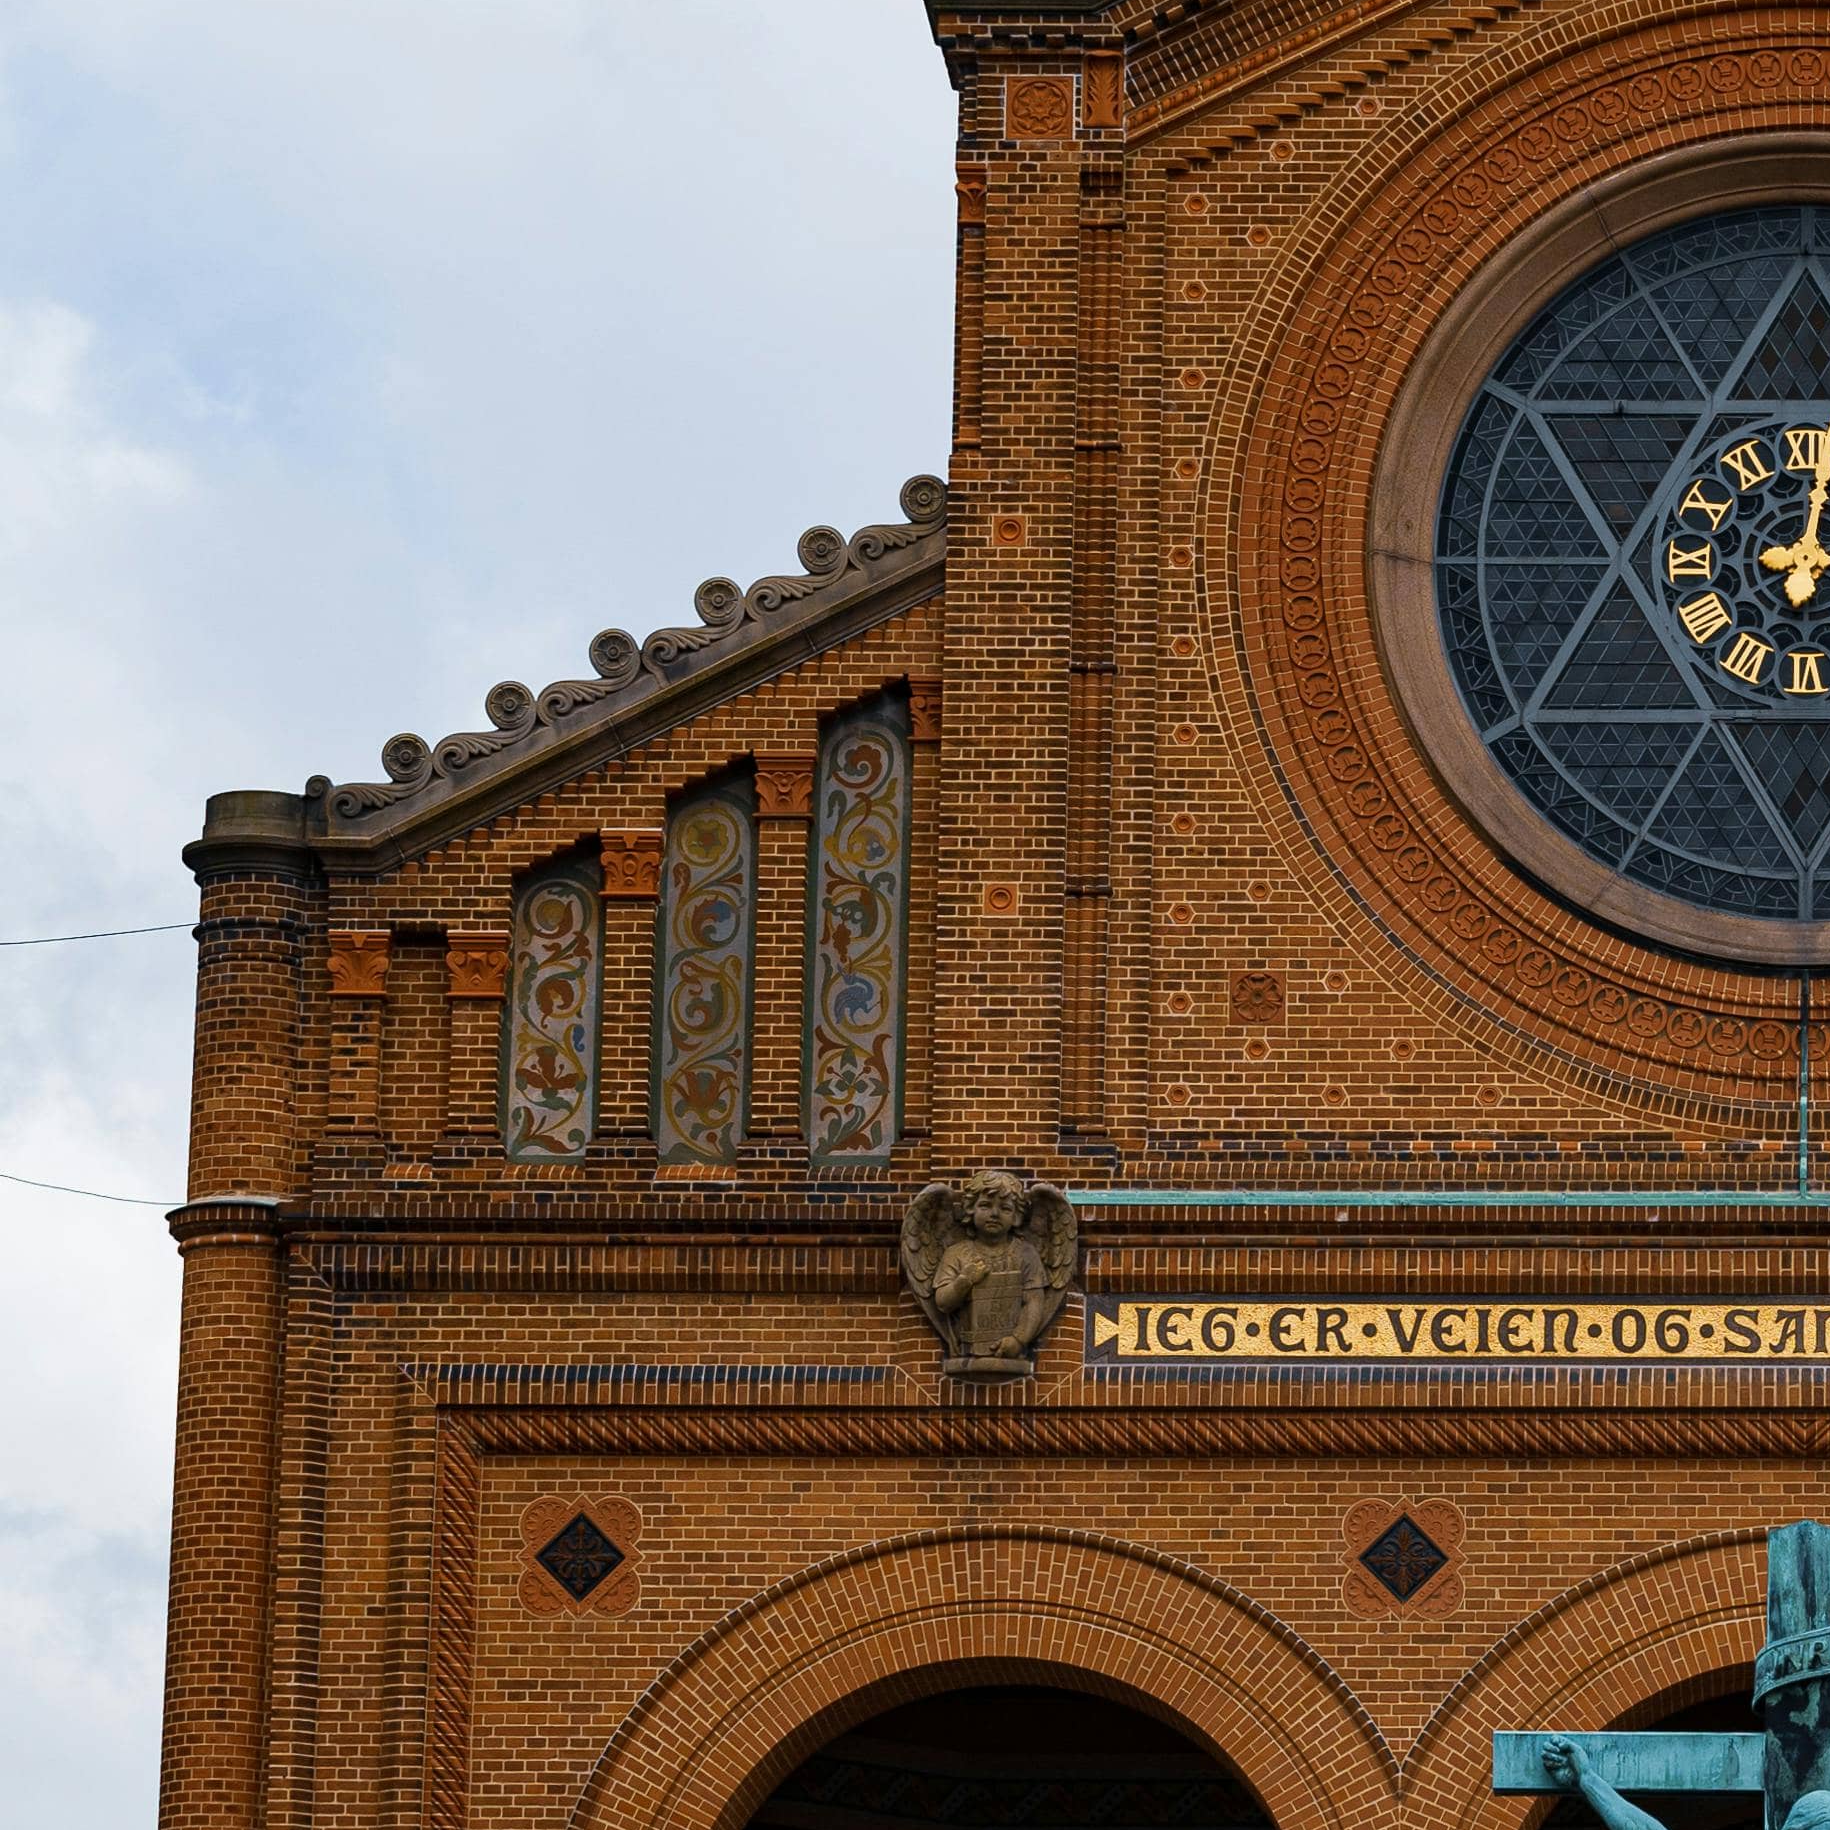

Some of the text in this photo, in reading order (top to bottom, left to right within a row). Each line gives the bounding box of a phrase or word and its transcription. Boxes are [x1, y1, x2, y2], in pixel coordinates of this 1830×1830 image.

[1720, 439, 1775, 491] XI
[1679, 480, 1734, 531] X
[1669, 540, 1711, 583] IX
[1679, 592, 1732, 644] VIII
[1719, 633, 1775, 684] VII
[1784, 653, 1829, 693] VI
[1269, 1307, 1352, 1353] ER
[1387, 1308, 1579, 1354] VEIEN
